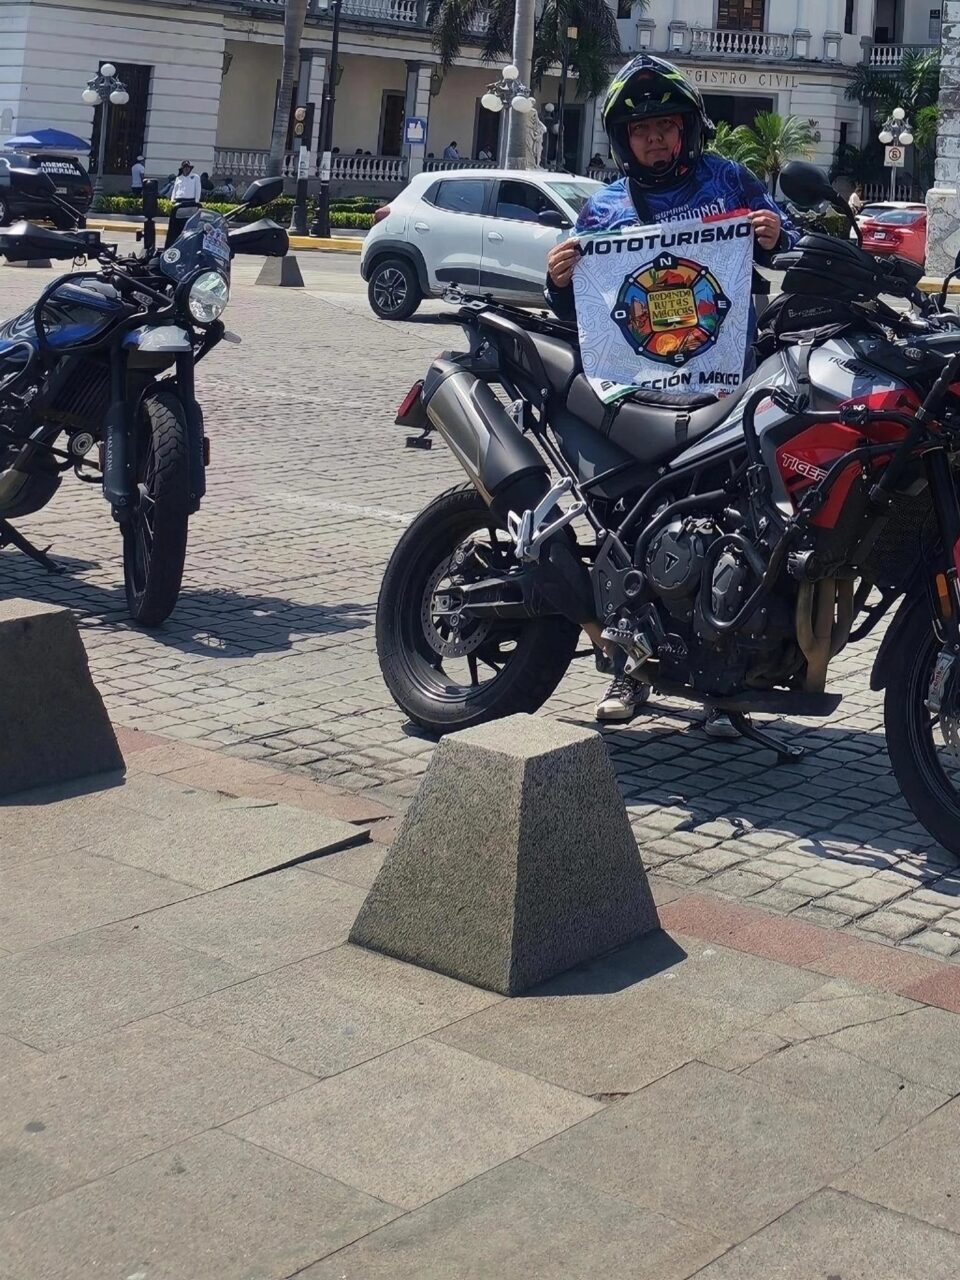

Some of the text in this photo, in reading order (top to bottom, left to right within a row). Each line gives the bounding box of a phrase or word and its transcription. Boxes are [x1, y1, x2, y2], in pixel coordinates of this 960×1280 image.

[685, 70, 798, 88] EGISTRO CIVIL
[41, 167, 82, 176] UNERARIA
[575, 223, 751, 256] MOTOTURISMO
